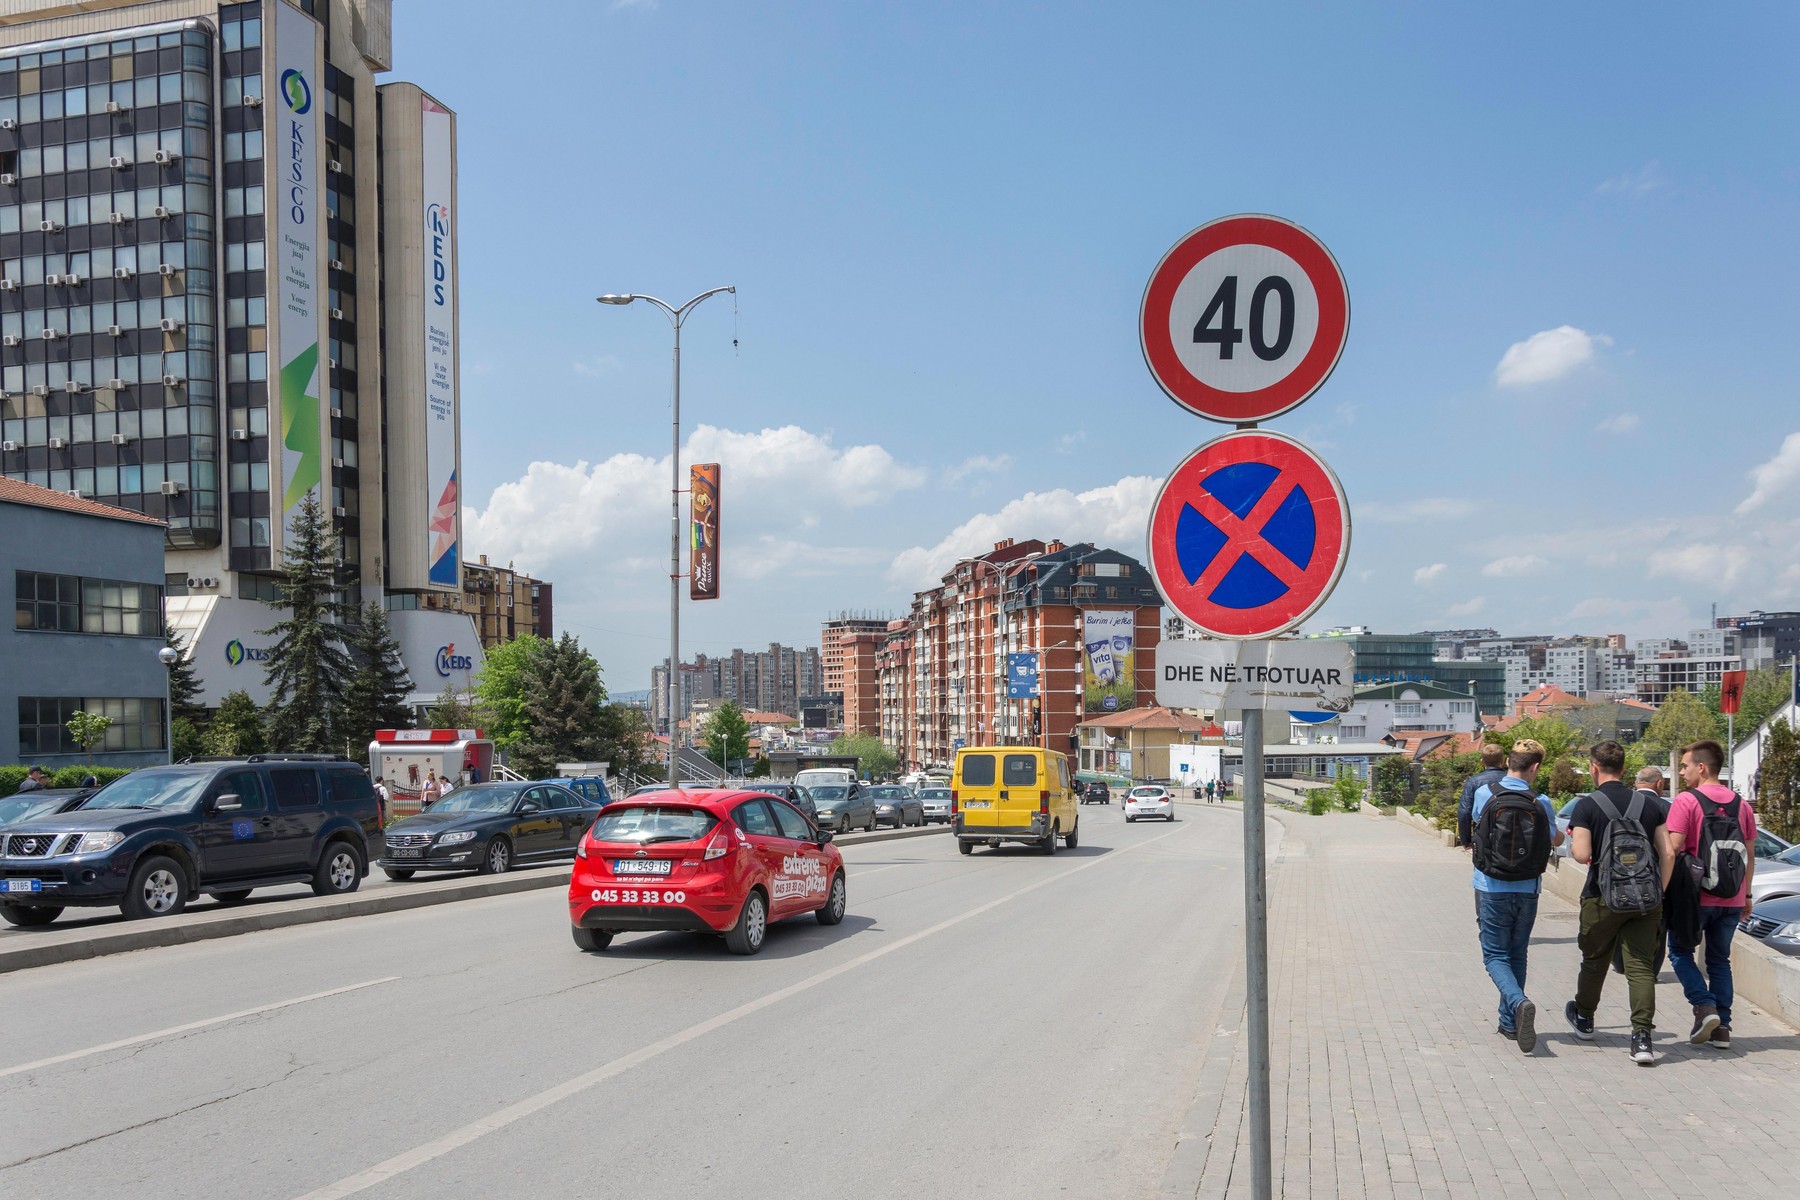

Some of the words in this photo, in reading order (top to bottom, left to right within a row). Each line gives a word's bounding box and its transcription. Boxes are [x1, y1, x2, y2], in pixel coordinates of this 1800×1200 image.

[290, 119, 305, 225] KESCO
[431, 207, 447, 306] KEDS
[291, 293, 306, 305] Your
[288, 304, 308, 317] energy
[1193, 275, 1295, 361] 40
[430, 394, 445, 406] Source
[1086, 616, 1107, 624] Burim
[1093, 653, 1110, 664] vita
[1165, 665, 1203, 682] DHE
[1210, 663, 1236, 682] NË
[1243, 666, 1341, 685] TROTUAR
[783, 852, 819, 875] extreme
[805, 875, 827, 897] pizza
[591, 889, 618, 902] 045
[621, 890, 638, 903] 33
[642, 891, 659, 903] 33
[663, 891, 686, 904] 00
